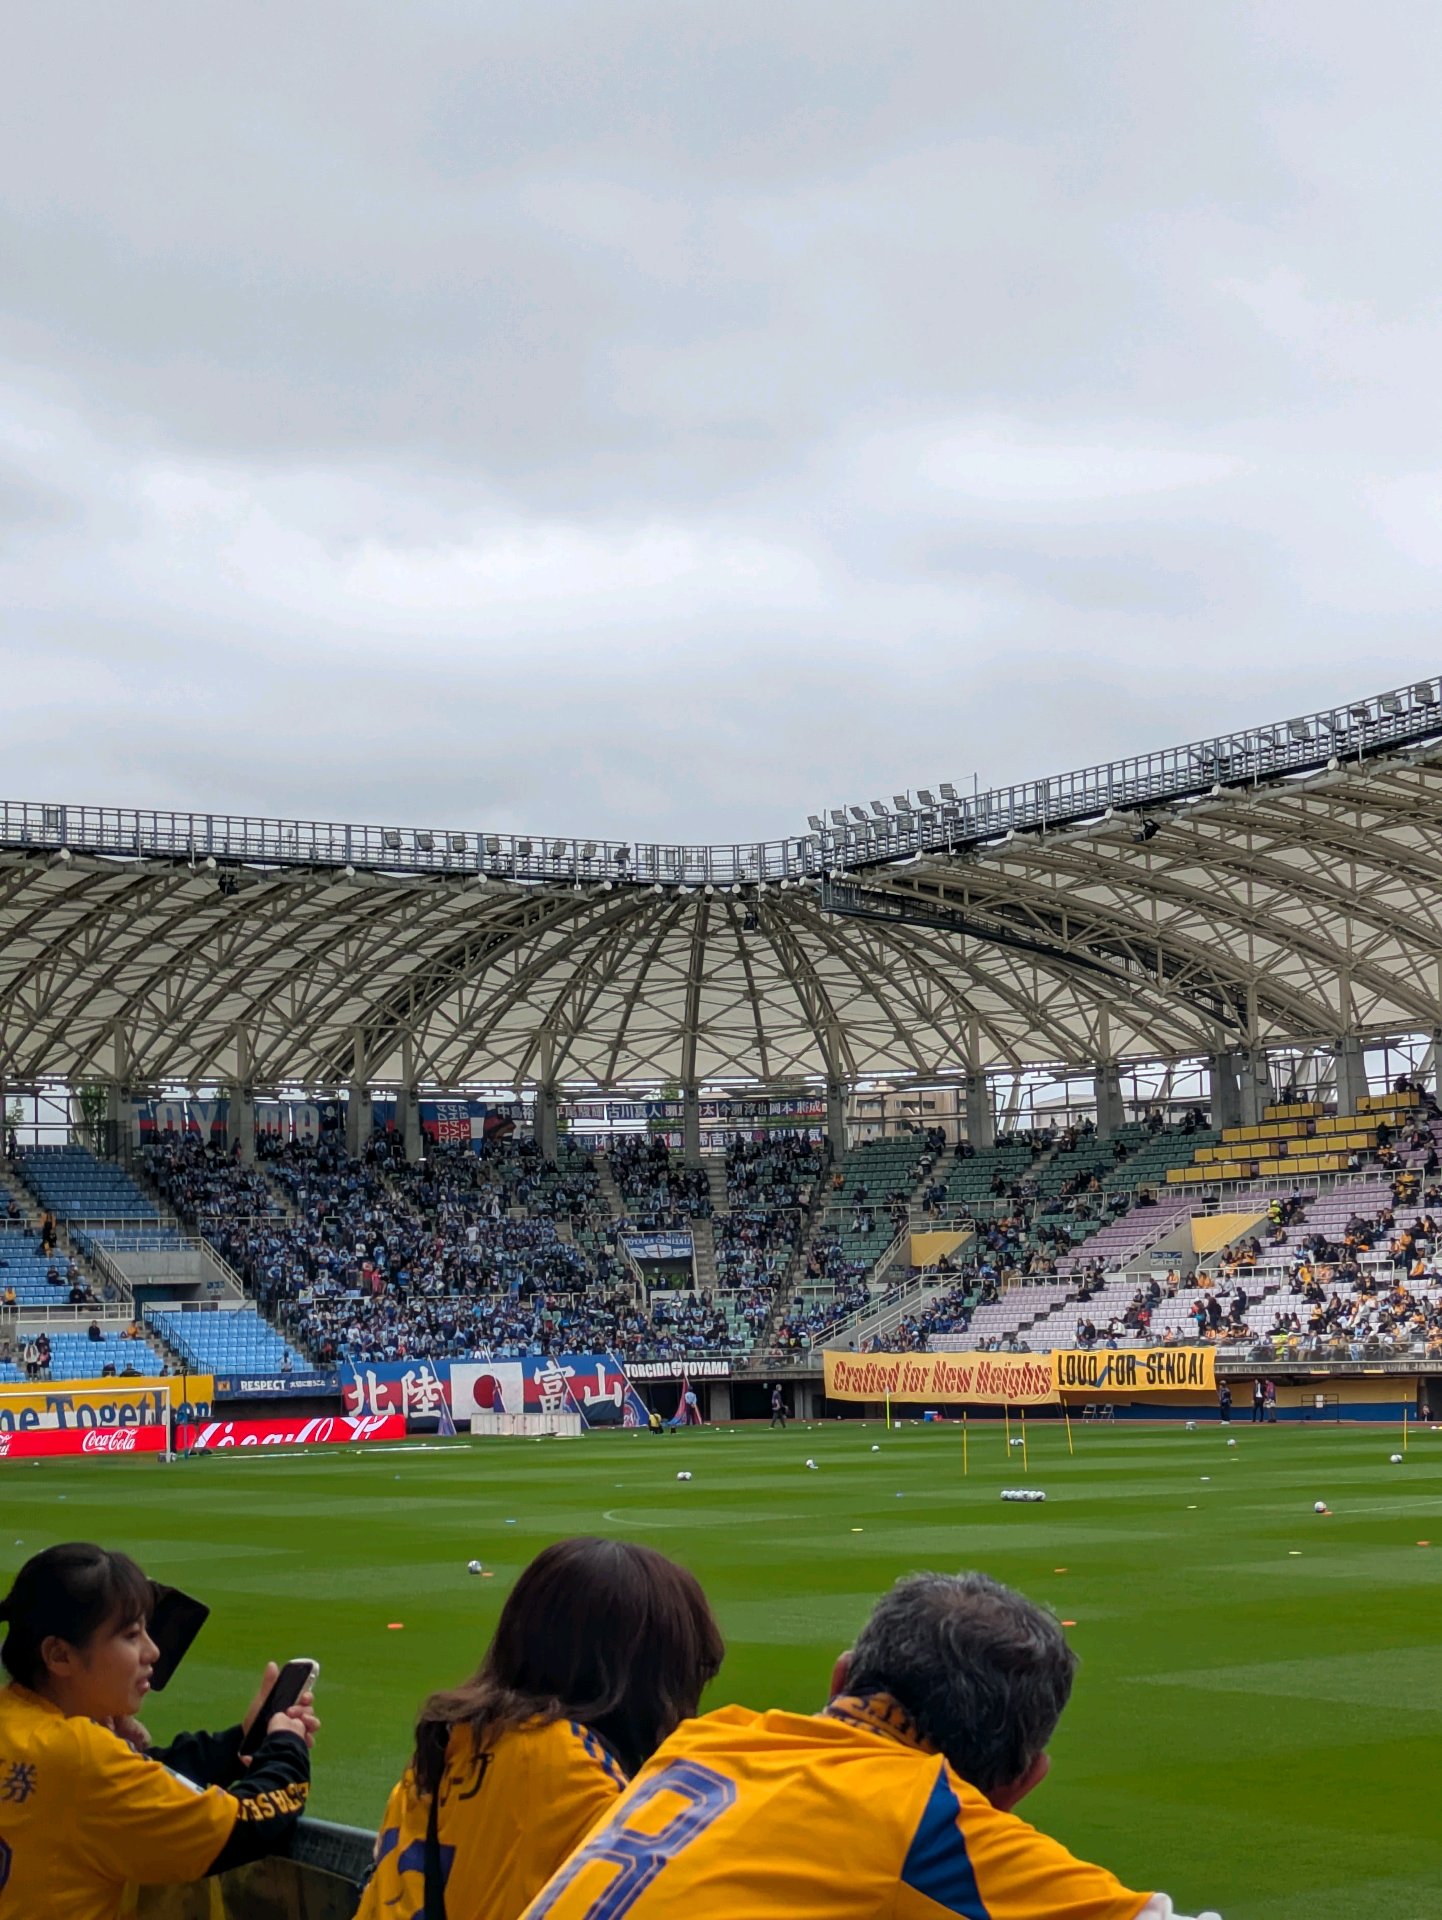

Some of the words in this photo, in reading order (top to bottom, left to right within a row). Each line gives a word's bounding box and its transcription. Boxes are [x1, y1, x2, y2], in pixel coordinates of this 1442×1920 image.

[624, 1362, 671, 1378] TORCIDA
[683, 1361, 729, 1376] TOYAMA
[902, 1361, 930, 1392] for
[932, 1360, 974, 1393] New
[976, 1361, 1053, 1399] Heights
[1058, 1354, 1098, 1386] LOUD
[1108, 1354, 1136, 1386] FOR
[1146, 1352, 1204, 1385] SENDAI
[240, 1380, 286, 1391] RESPECT
[348, 1365, 444, 1419] 北陸
[533, 1360, 622, 1414] 富山
[82, 1429, 138, 1452] Coca-Cola
